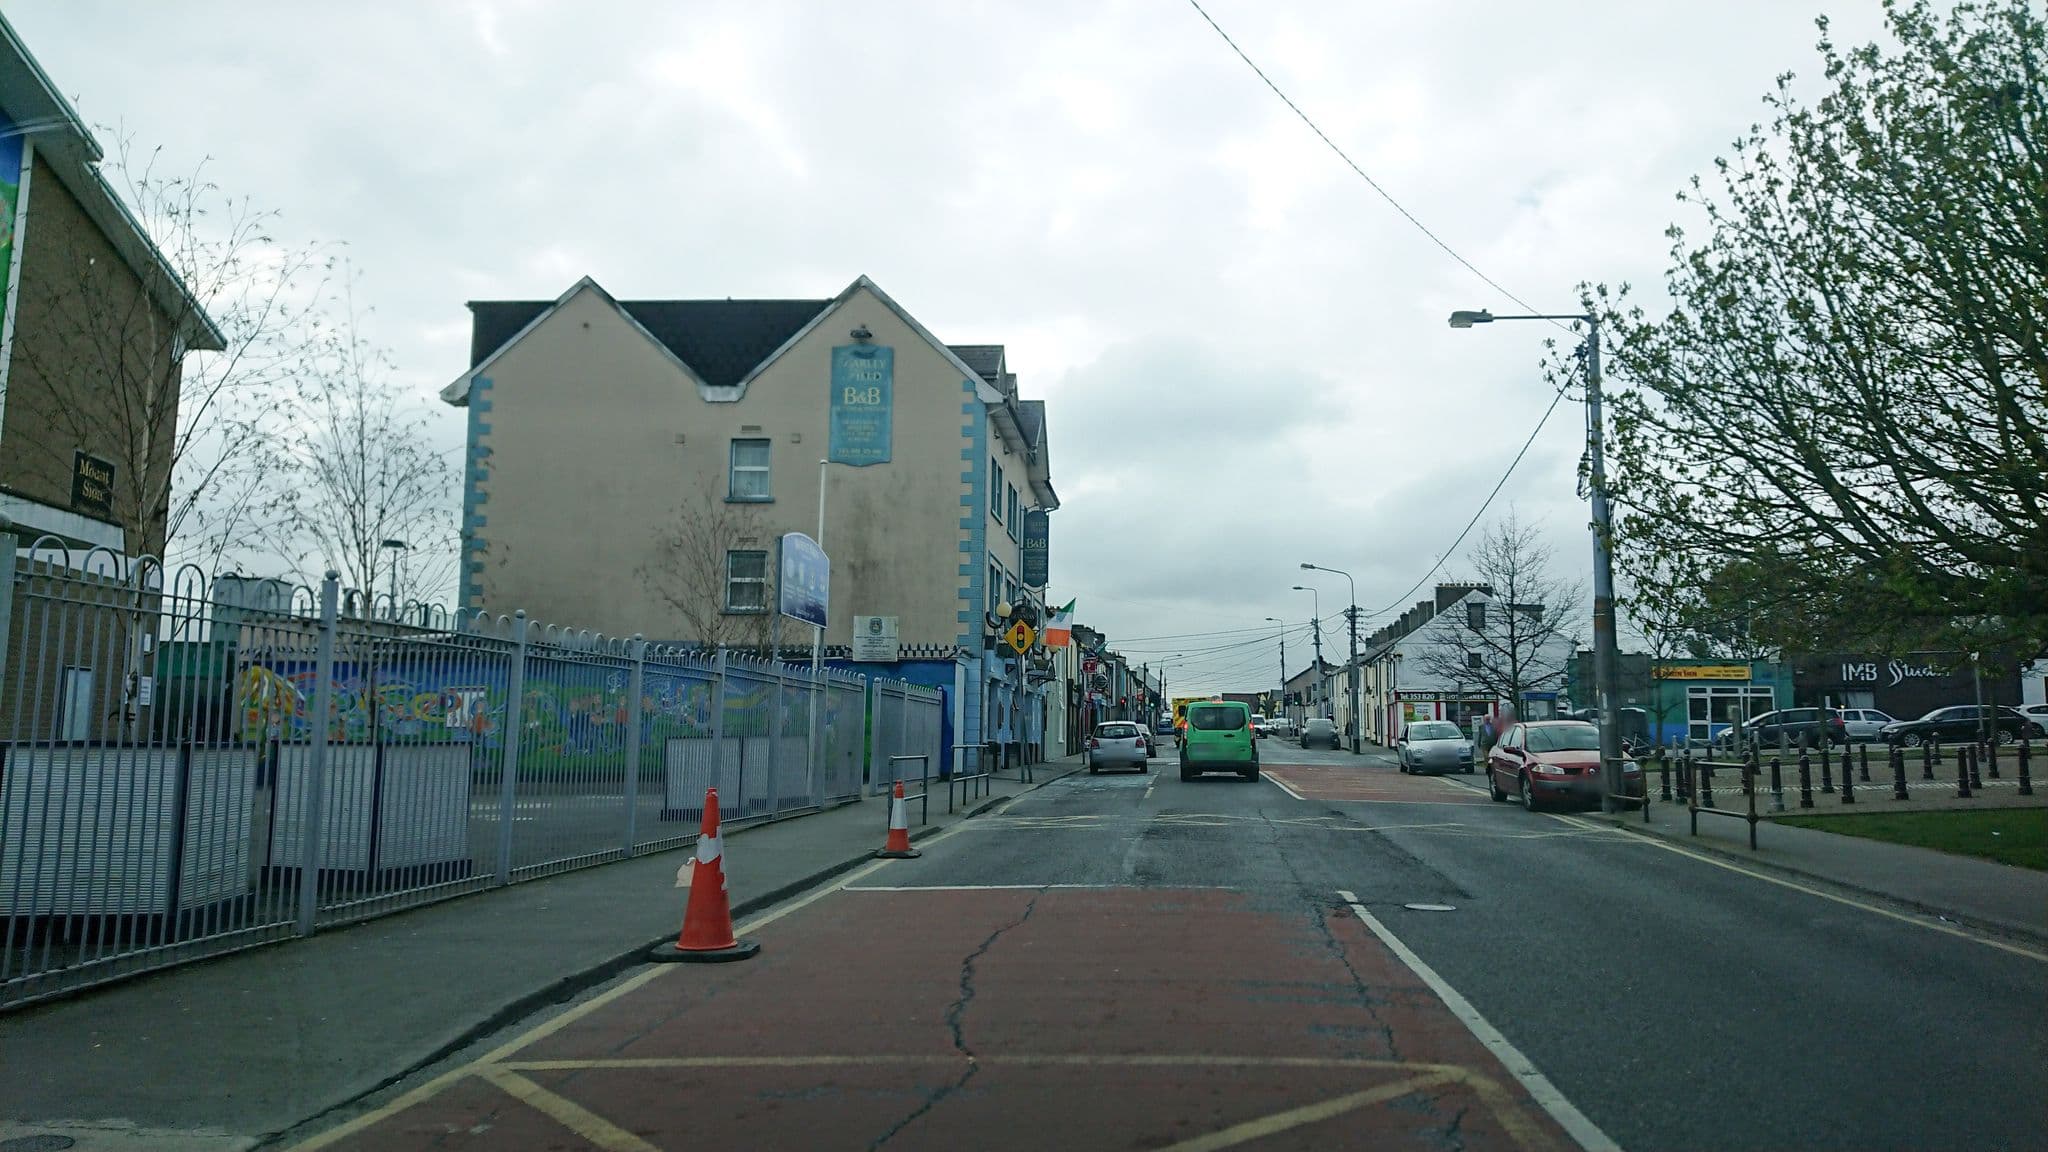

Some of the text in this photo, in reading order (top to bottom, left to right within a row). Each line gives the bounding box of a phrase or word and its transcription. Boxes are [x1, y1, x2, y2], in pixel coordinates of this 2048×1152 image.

[844, 386, 881, 405] B&B
[1026, 537, 1047, 549] B&B
[1842, 663, 1878, 681] IMB
